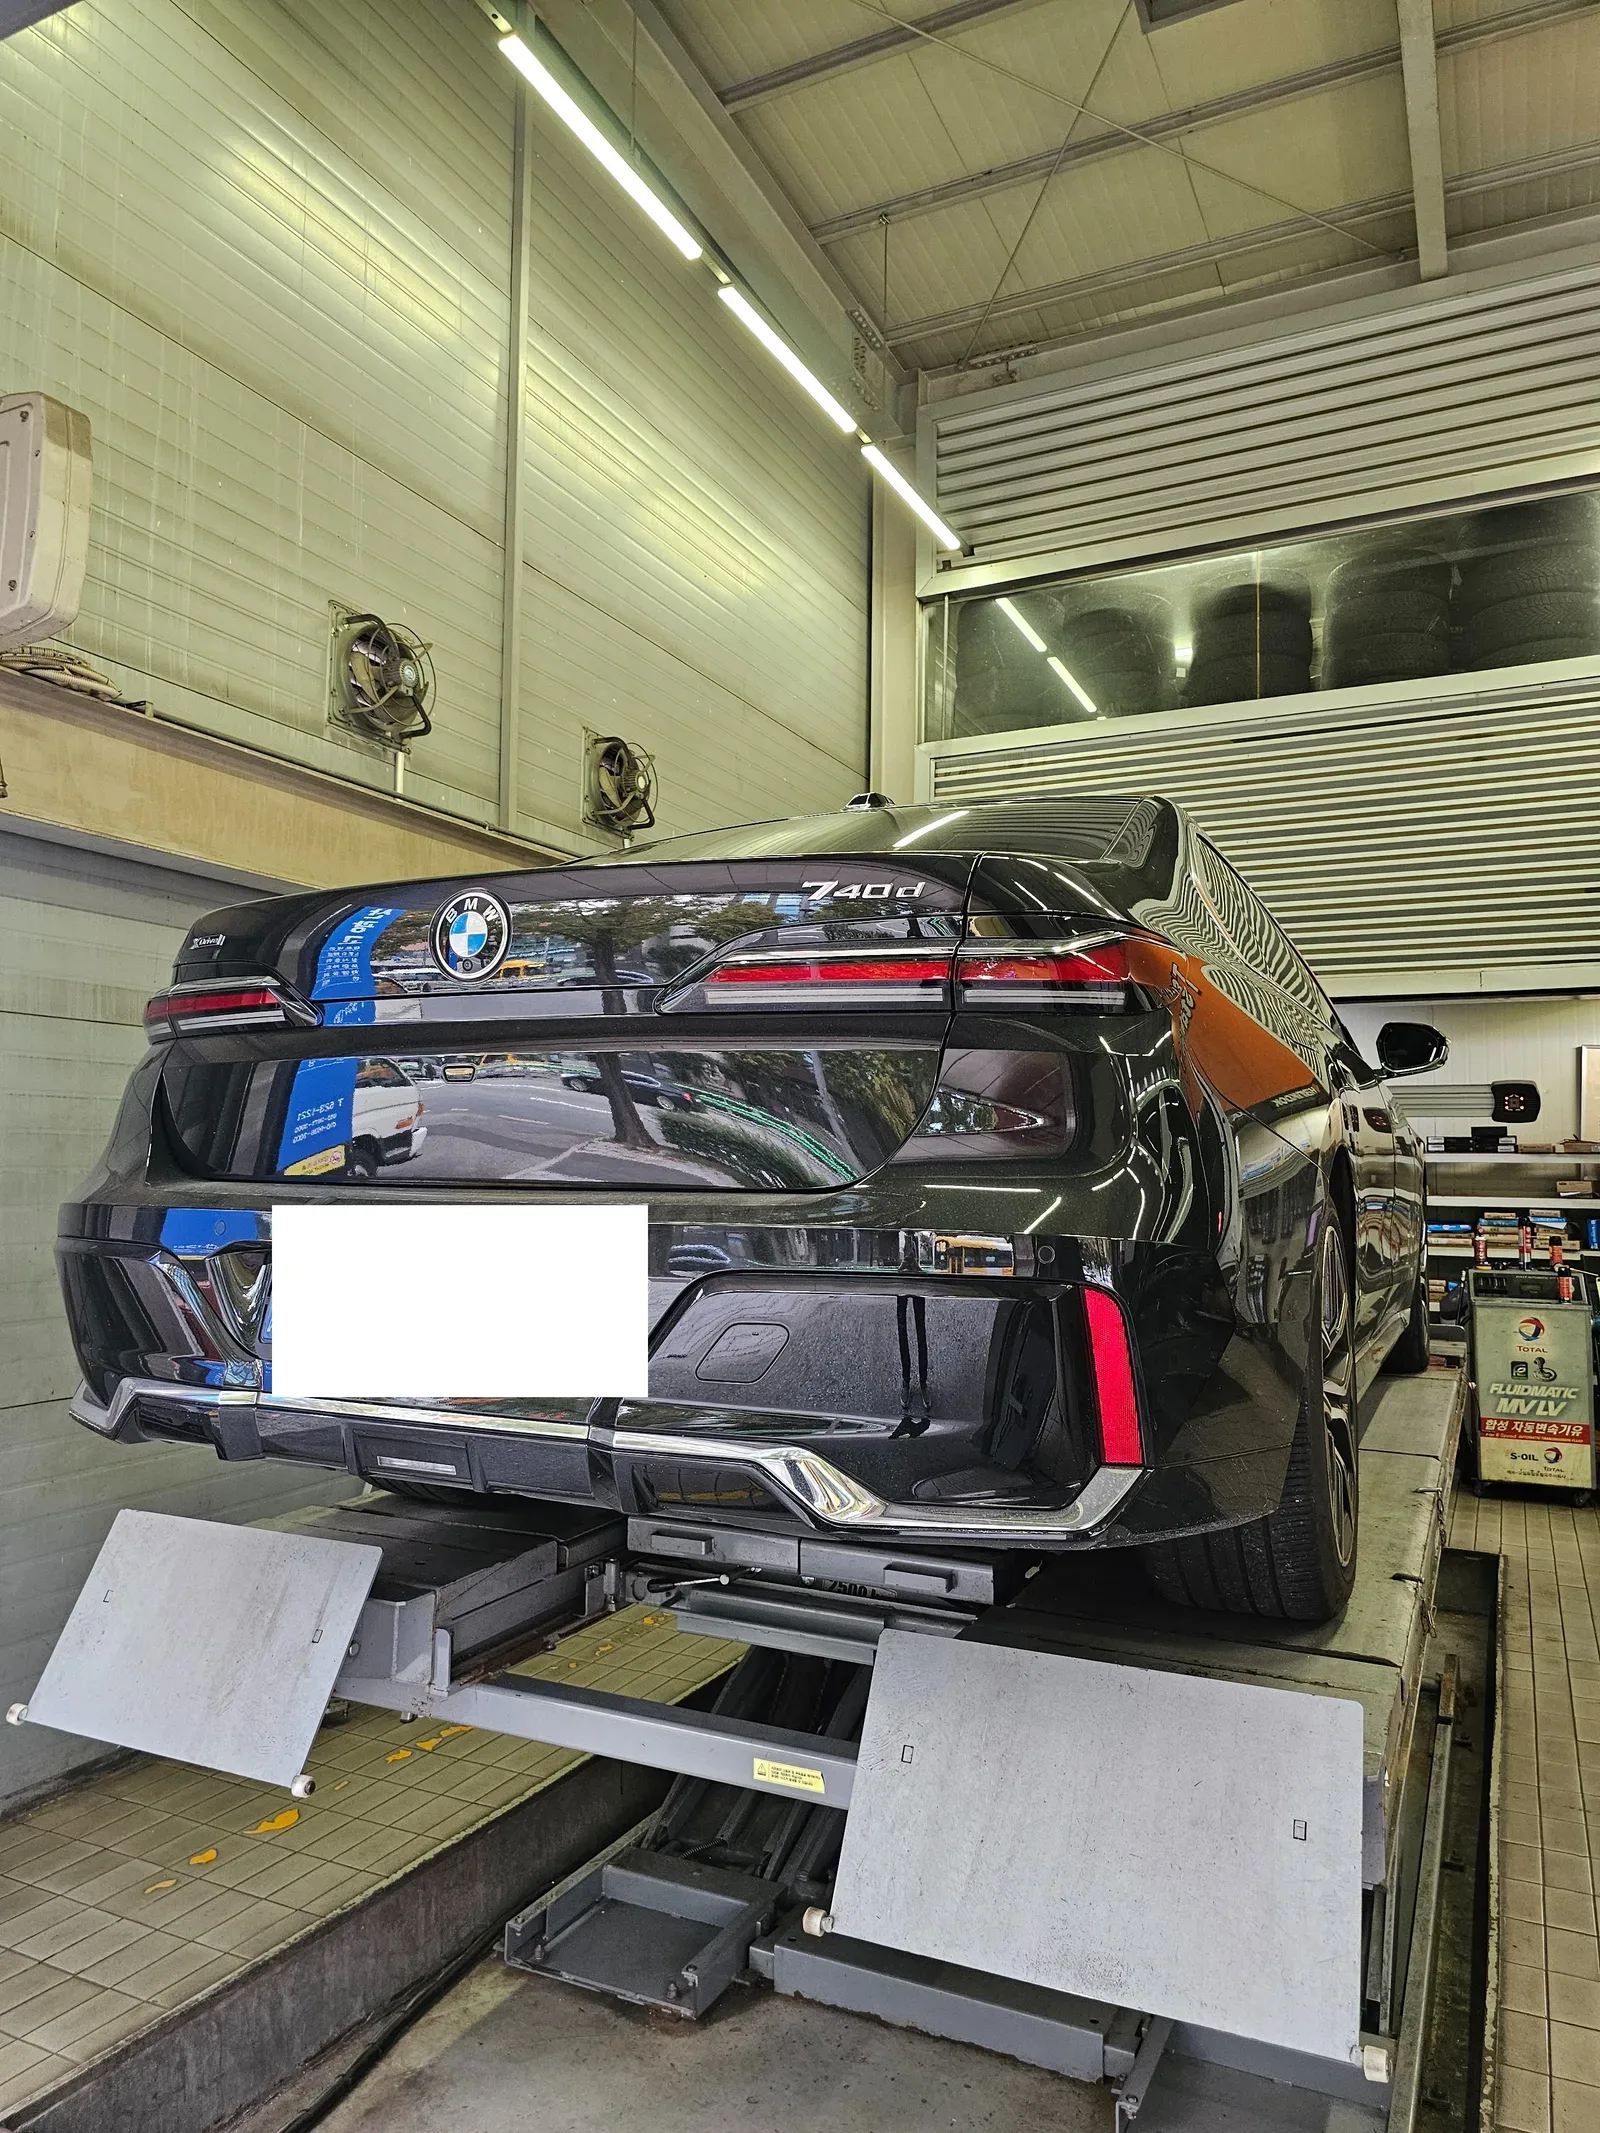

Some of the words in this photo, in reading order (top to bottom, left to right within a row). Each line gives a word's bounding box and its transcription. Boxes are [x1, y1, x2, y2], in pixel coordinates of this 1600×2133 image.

[801, 880, 926, 901] 740d
[445, 897, 500, 924] BMW
[1516, 1345, 1549, 1354] TOTAL
[1489, 1383, 1580, 1399] FLUIDMATIC
[1495, 1397, 1538, 1415] MV
[1535, 1400, 1568, 1417] LV
[1485, 1419, 1509, 1431] 합성
[1511, 1421, 1584, 1437] 자동변속기유
[1510, 1452, 1539, 1461] S-OIL
